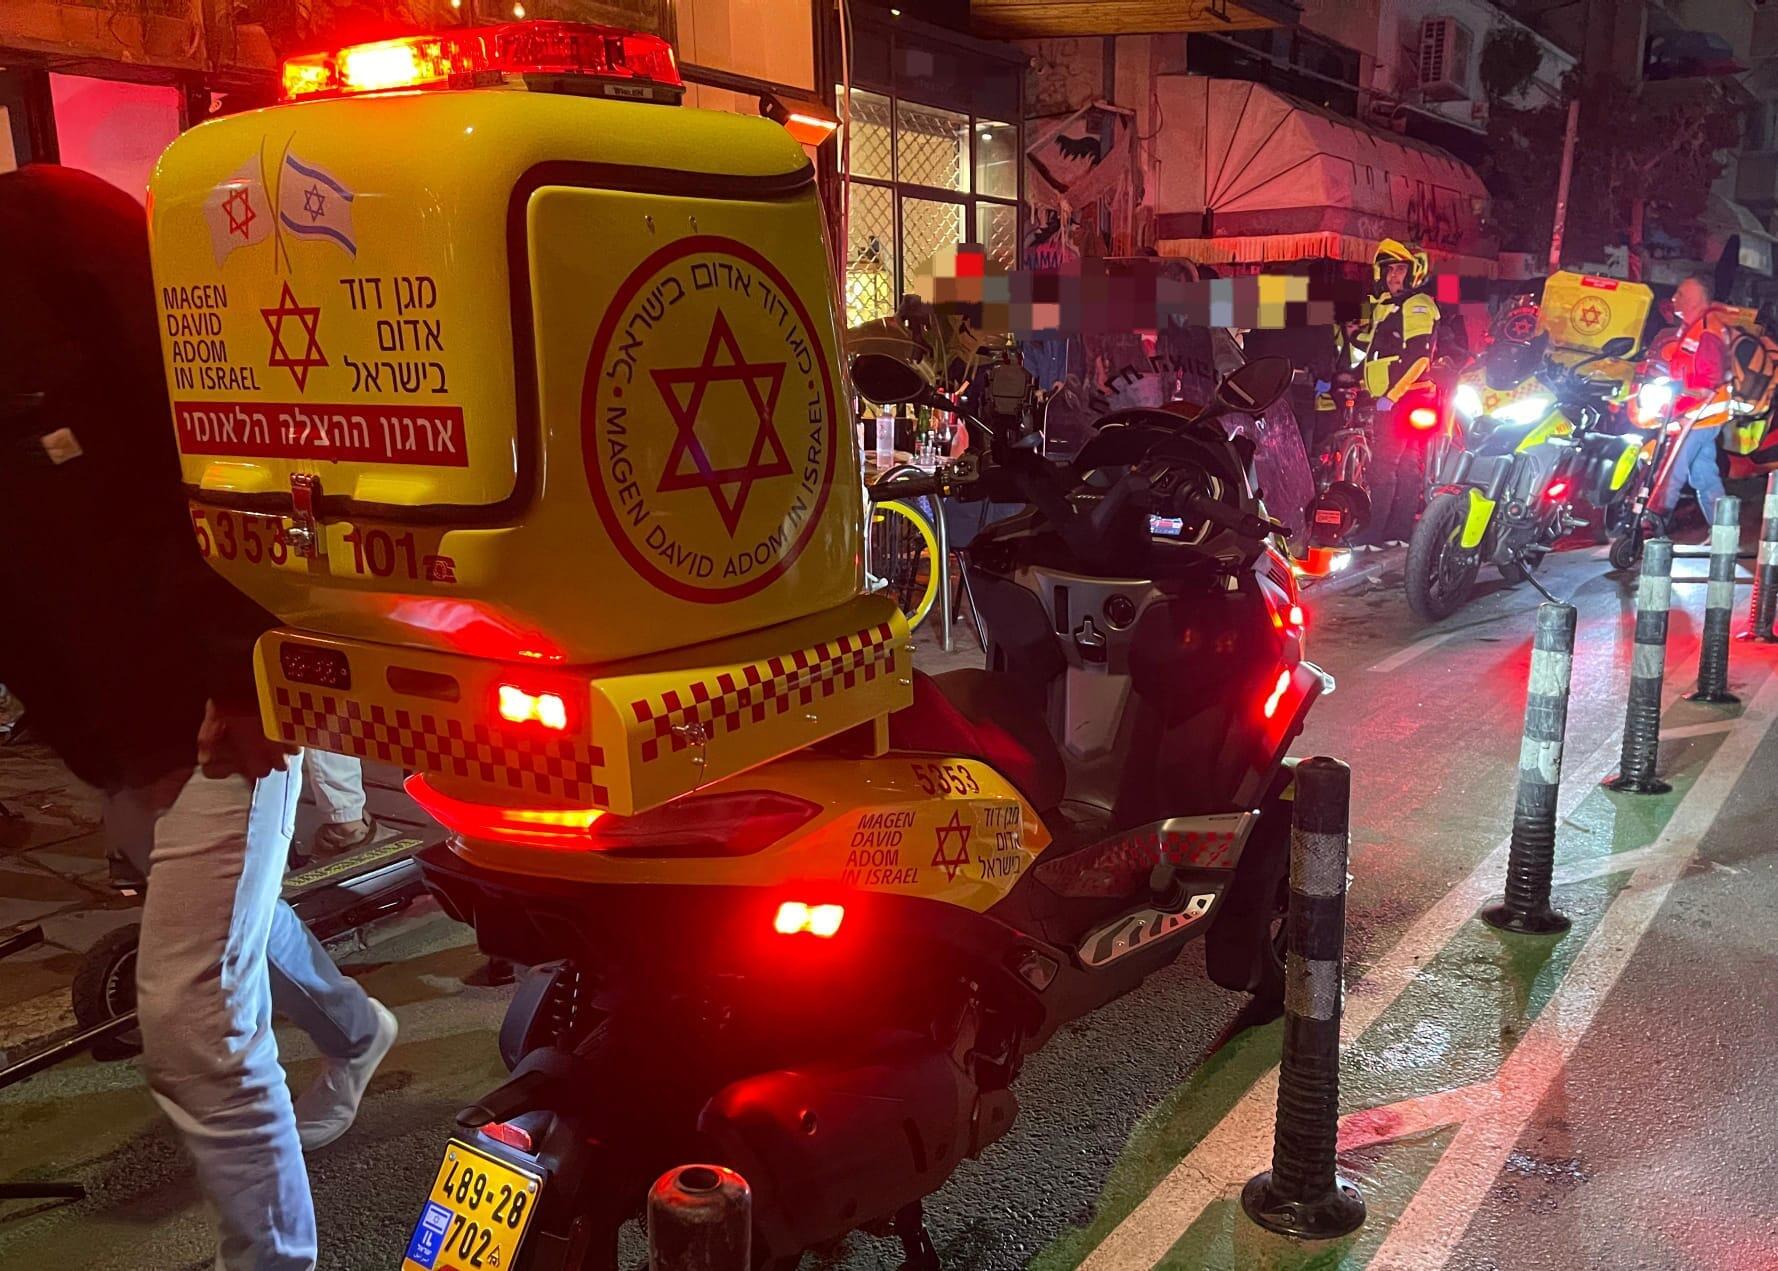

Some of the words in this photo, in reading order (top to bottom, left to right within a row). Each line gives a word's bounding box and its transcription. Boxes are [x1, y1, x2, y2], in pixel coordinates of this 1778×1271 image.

[339, 278, 383, 310] דוד
[394, 276, 438, 316] מגן
[691, 261, 751, 297] אדום
[163, 284, 228, 310] MAGEN
[758, 281, 789, 327] דוד
[167, 312, 222, 337] DAVID
[376, 319, 444, 351] אדום
[606, 275, 687, 385] בישראל
[173, 339, 228, 363] ADOM
[785, 325, 813, 375] מגן
[174, 366, 194, 390] IN
[199, 366, 261, 391] ISRAEL
[343, 354, 449, 393] בישראל
[183, 405, 271, 444] הלאומי
[279, 406, 370, 448] ההצלה
[380, 416, 456, 457] ארגון
[606, 406, 650, 527] MAGEN
[646, 524, 714, 578] DAVID
[723, 525, 788, 578] ADOM
[789, 495, 810, 528] IN
[800, 391, 822, 494] ISRAEL
[191, 509, 288, 566] 5353
[343, 527, 418, 580] 101
[912, 764, 980, 796] 5353
[857, 812, 916, 830] MAGEN
[984, 807, 1002, 827] דוד
[1004, 806, 1019, 829] מגן
[851, 830, 903, 848] DAVID
[846, 849, 899, 868] ADOM
[978, 855, 1020, 879] בישראל
[841, 868, 864, 885] IN
[865, 867, 919, 886] ISRAEL
[443, 1161, 527, 1229] 489-28
[444, 1214, 492, 1268] 702
